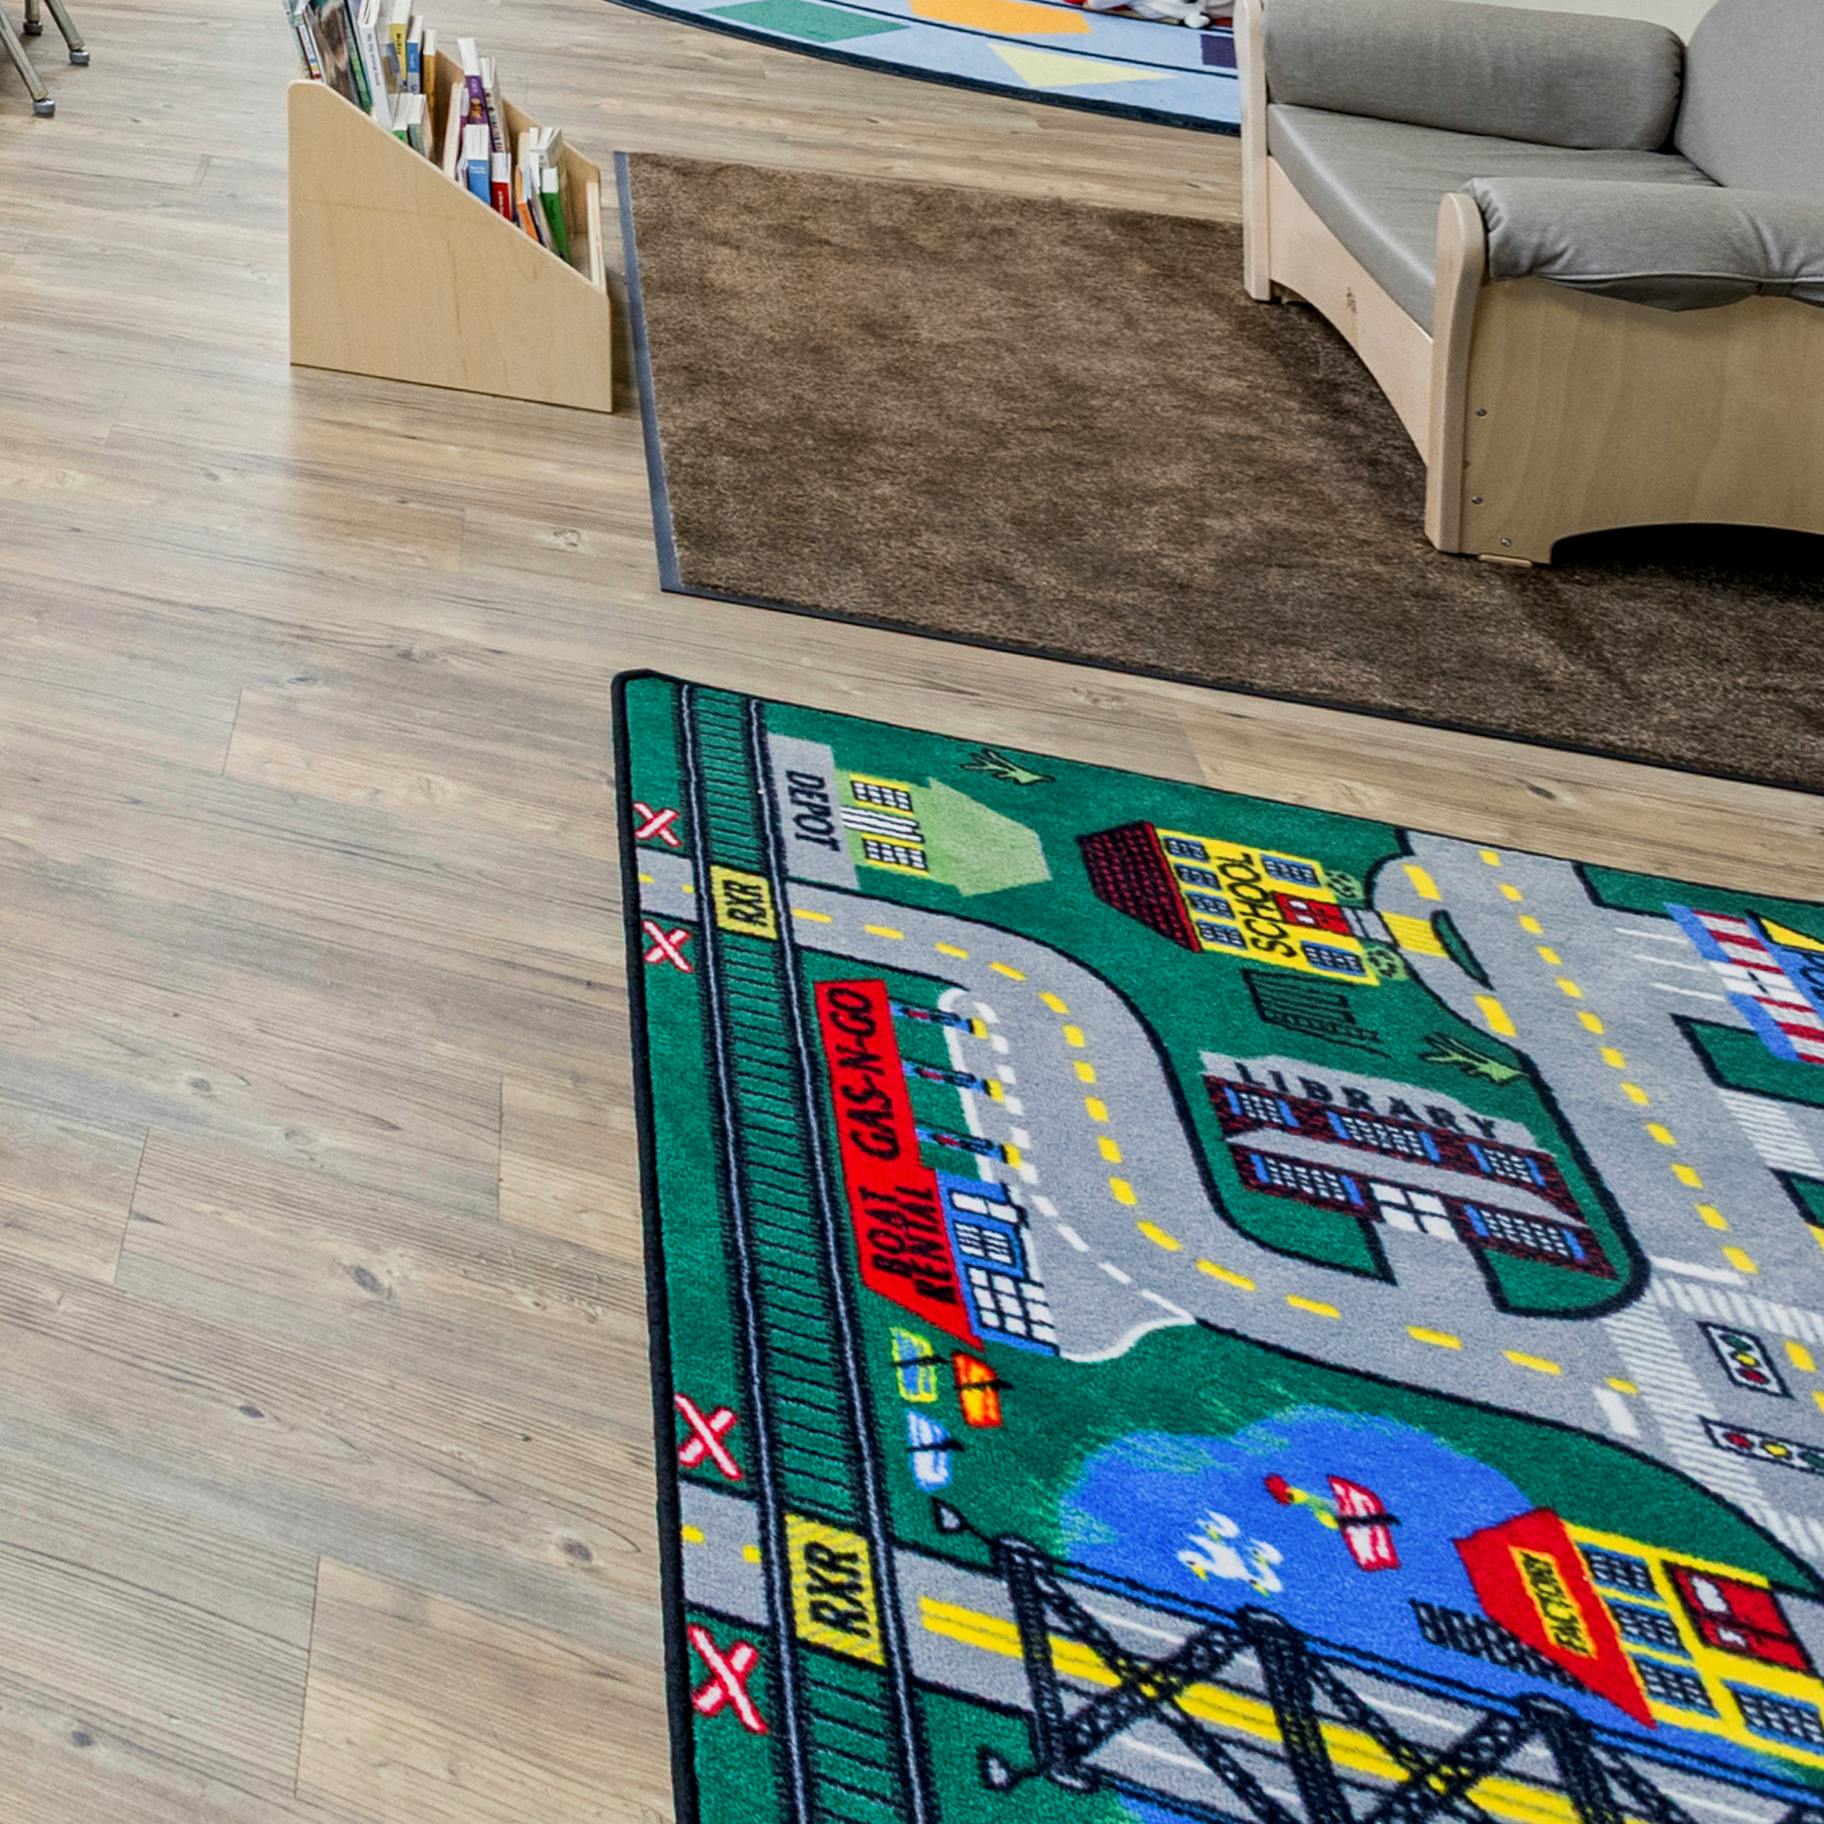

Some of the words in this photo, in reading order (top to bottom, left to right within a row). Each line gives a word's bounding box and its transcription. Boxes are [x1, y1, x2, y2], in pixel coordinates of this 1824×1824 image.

[785, 770, 841, 852] DEPOT
[722, 879, 769, 927] RXR
[1217, 852, 1298, 958] SCHOOL
[826, 986, 901, 1161] GAS-N-GO
[1235, 1061, 1497, 1139] LIBRARY
[858, 1185, 913, 1280] BOAT
[896, 1185, 957, 1305] RENTAL
[803, 1541, 872, 1638] RXR
[1518, 1550, 1591, 1655] FACTORY
